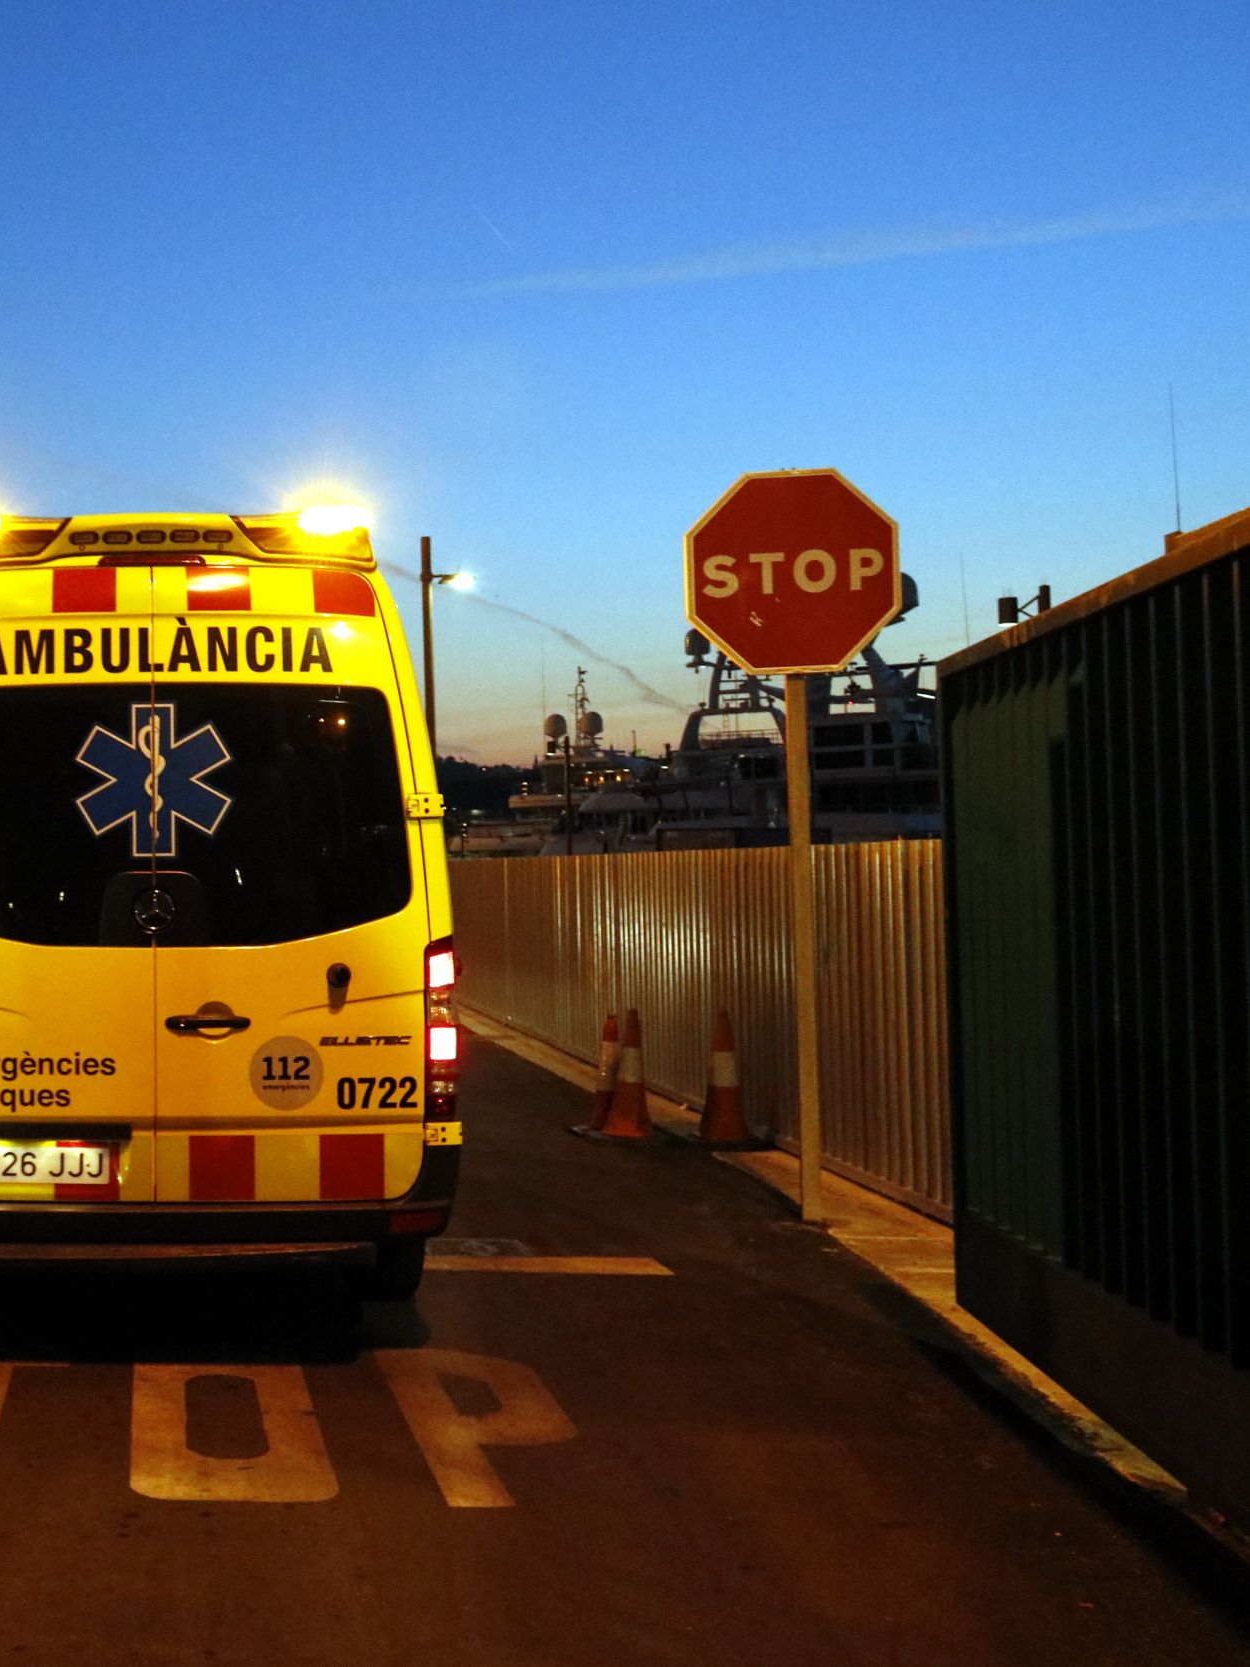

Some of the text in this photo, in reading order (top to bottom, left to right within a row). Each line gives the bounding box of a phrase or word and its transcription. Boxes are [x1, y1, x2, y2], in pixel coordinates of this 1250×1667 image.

[702, 548, 884, 598] STOP
[262, 1055, 311, 1080] 112
[337, 1076, 418, 1109] 0722
[48, 1152, 104, 1178] JJJ
